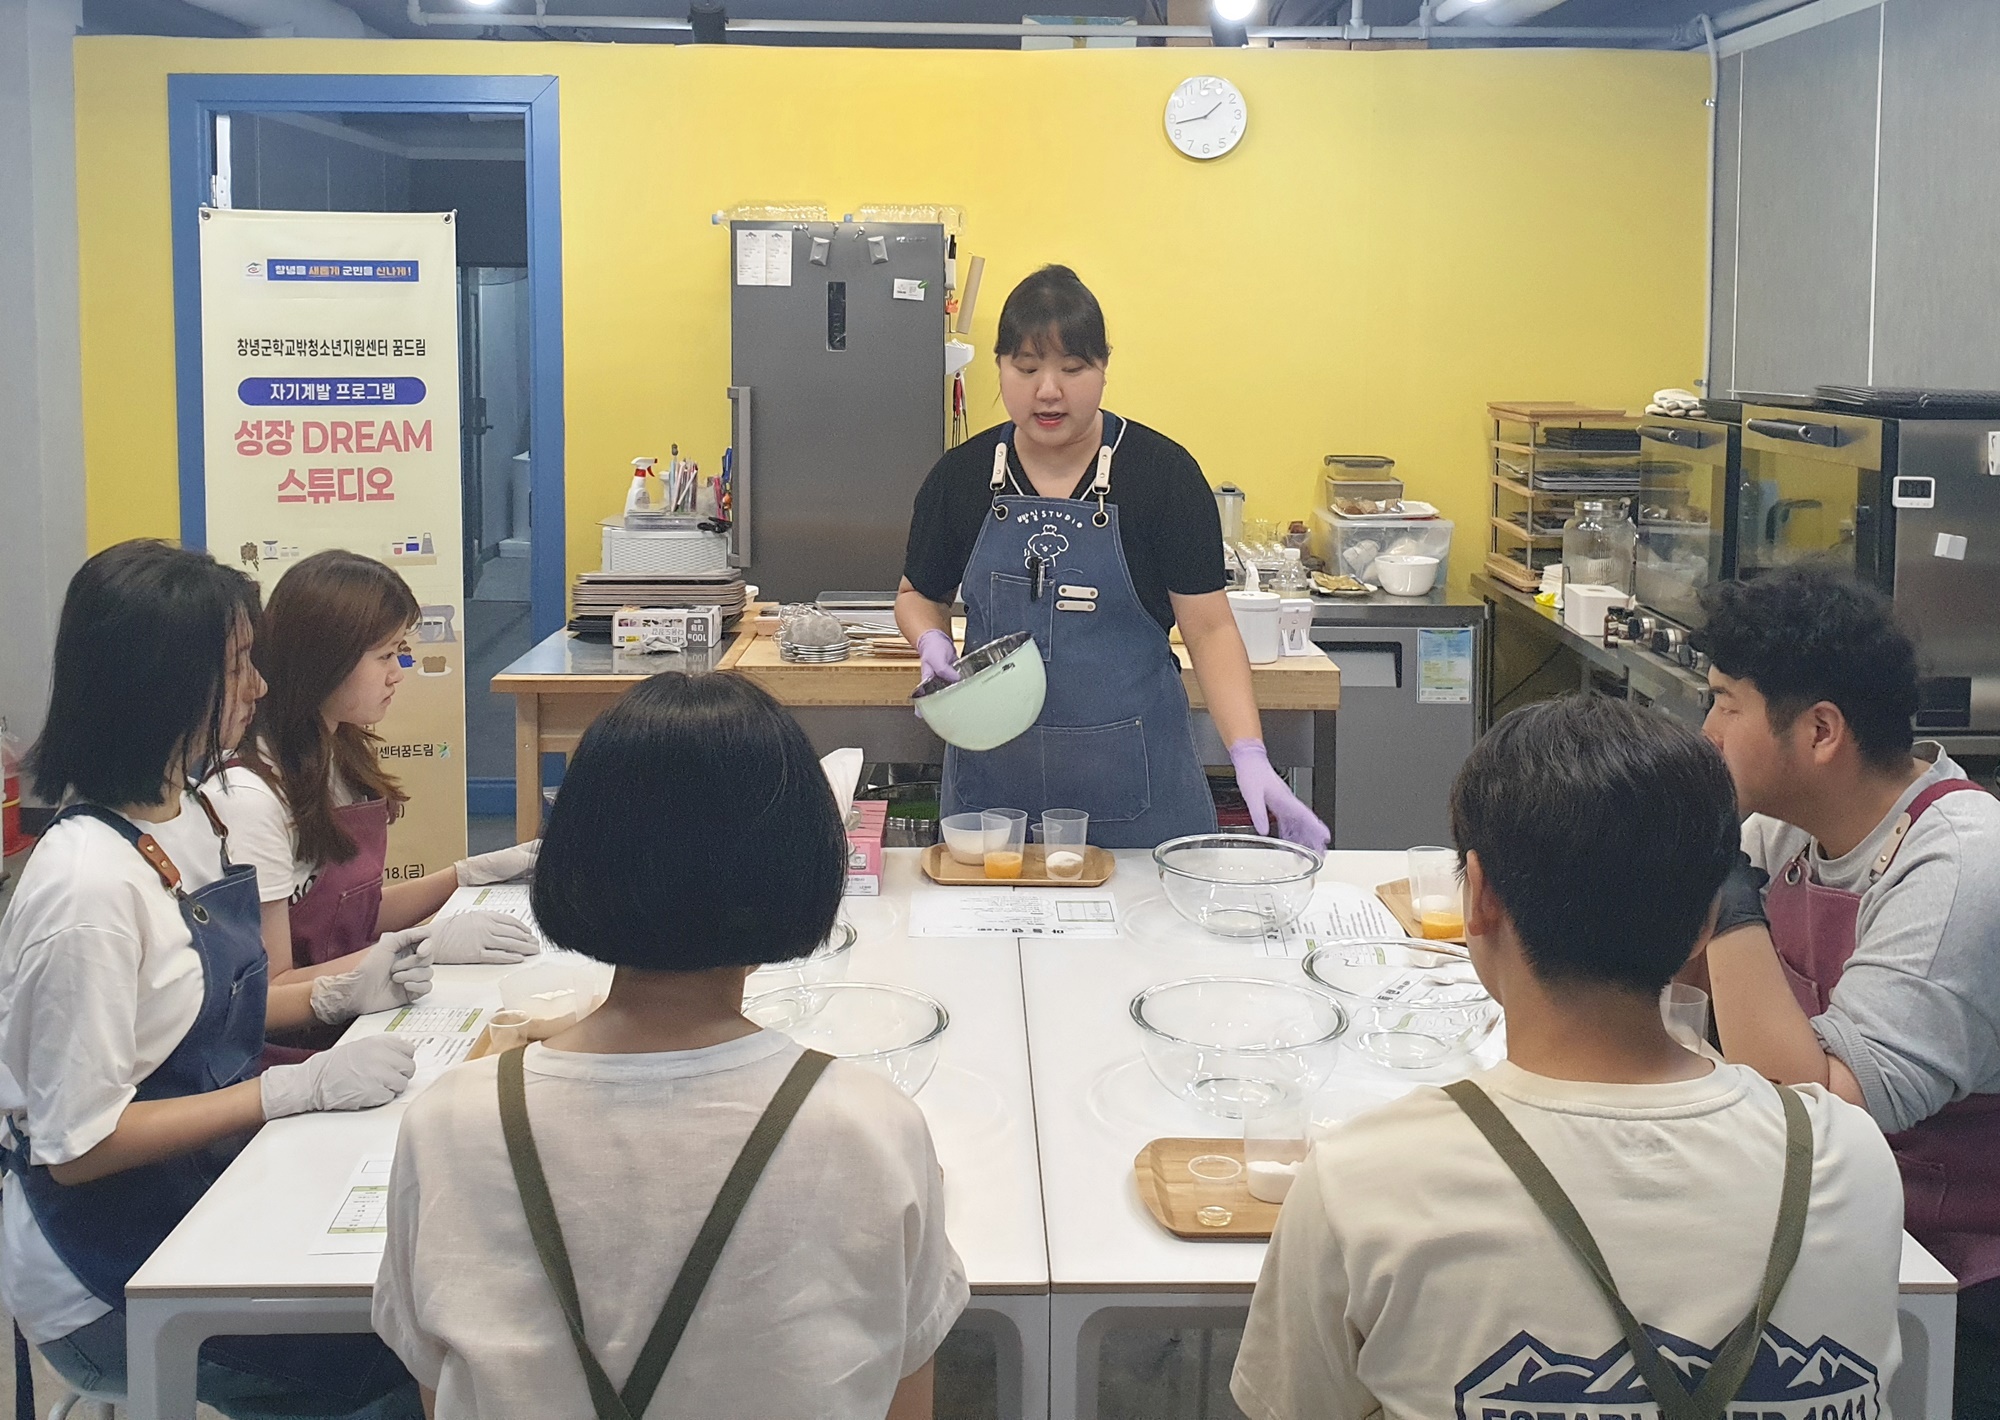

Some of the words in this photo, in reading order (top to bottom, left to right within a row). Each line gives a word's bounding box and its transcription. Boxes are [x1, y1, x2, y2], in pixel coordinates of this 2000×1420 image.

[1184, 85, 1193, 96] 11
[1199, 79, 1211, 90] 12
[1173, 97, 1184, 109] 10
[1228, 93, 1236, 104] 2
[1168, 113, 1176, 124] 9
[1234, 109, 1242, 120] 3
[1174, 128, 1182, 139] 8
[1230, 125, 1238, 136] 4
[1187, 139, 1195, 151] 7
[1202, 143, 1210, 154] 6
[1218, 137, 1227, 149] 5
[275, 265, 307, 276] 창녕을
[309, 265, 340, 277] 새롭게
[342, 266, 373, 276] 군민을
[376, 266, 412, 277] 신나게!
[237, 338, 388, 357] 창녕군학교밖청소년지원센터
[392, 338, 426, 357] 꿈드림
[270, 383, 331, 400] 자기계발
[336, 382, 396, 400] 프로그램
[234, 420, 295, 456] 성장
[302, 419, 433, 454] DREAM
[277, 466, 395, 504] 스튜디오
[1041, 510, 1083, 528] STUDIO
[376, 744, 434, 759] 센터꿈드림
